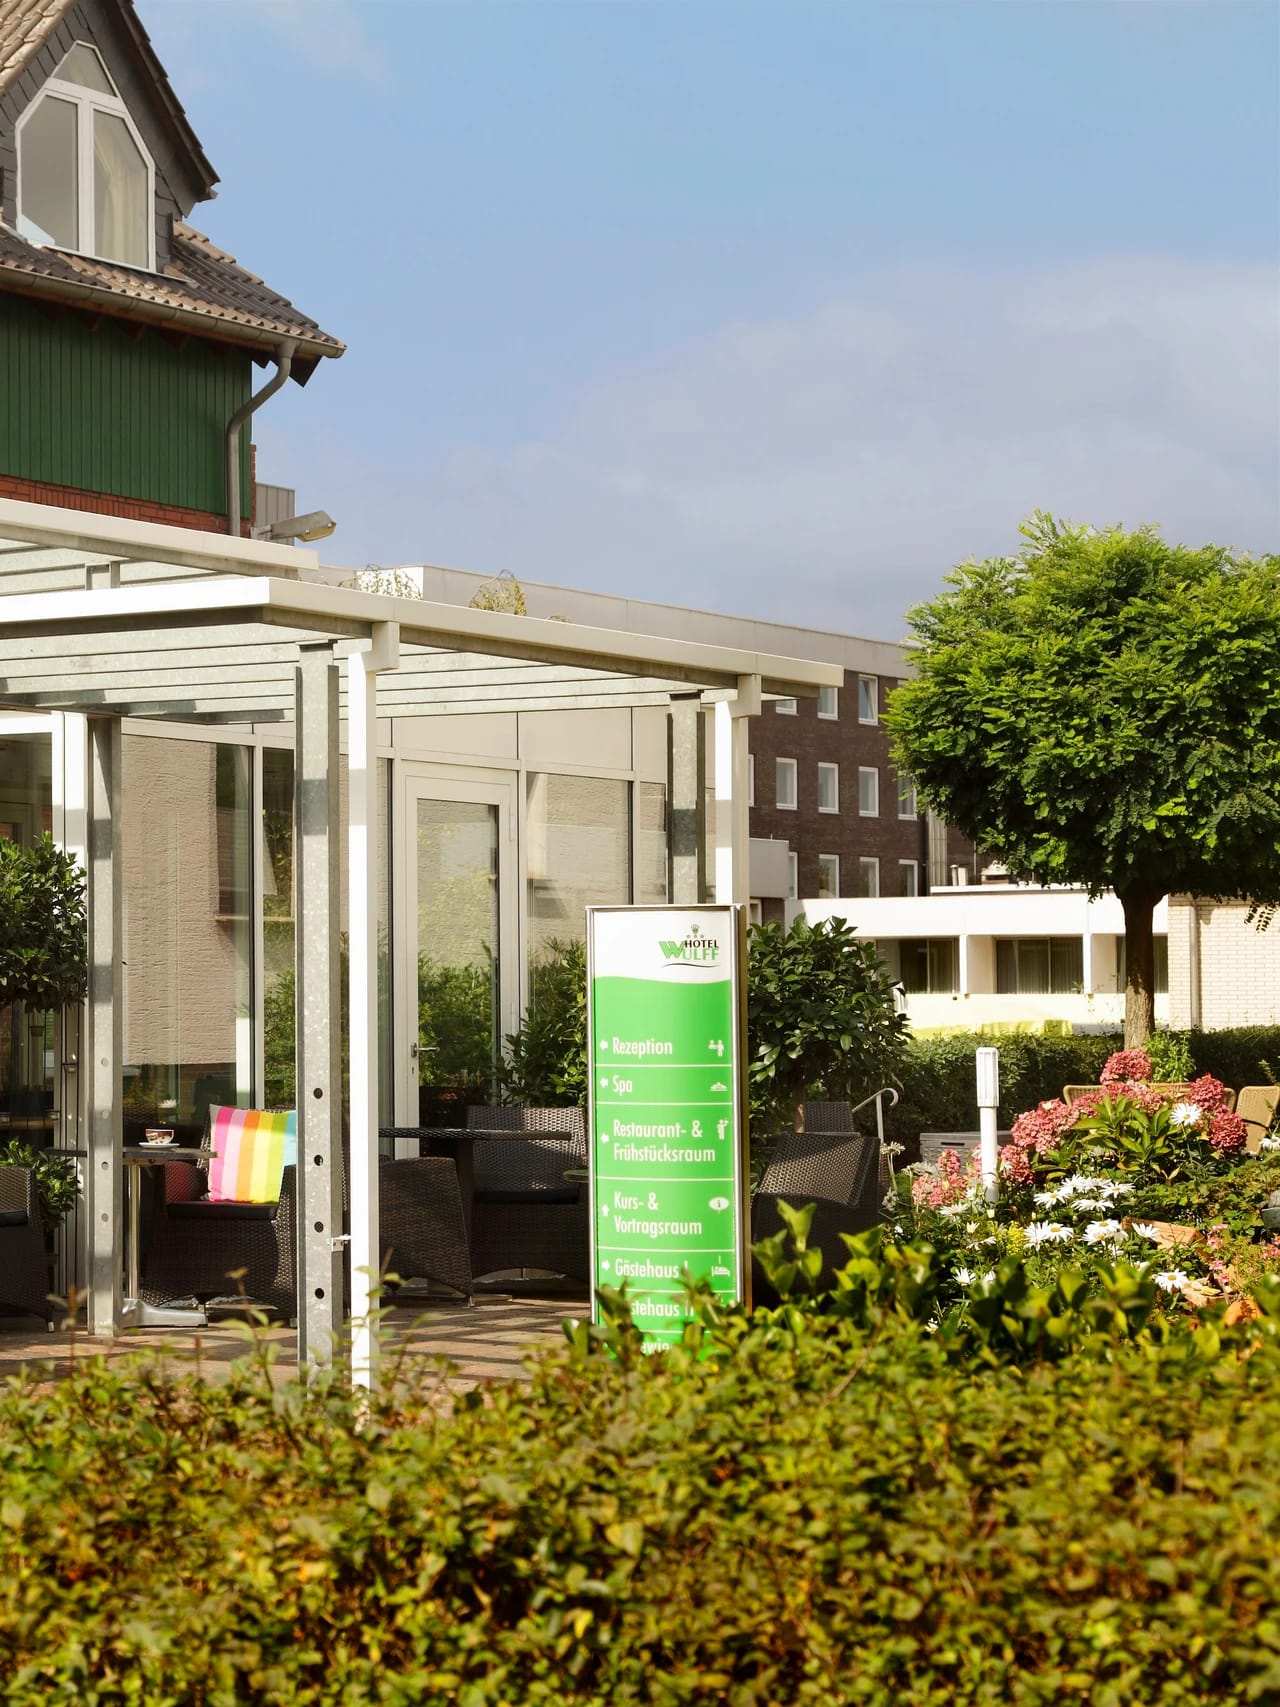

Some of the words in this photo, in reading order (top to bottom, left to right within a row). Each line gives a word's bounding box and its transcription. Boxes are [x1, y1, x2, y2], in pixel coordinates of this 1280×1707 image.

[658, 940, 719, 961] WULFF
[684, 939, 719, 949] HOTEL
[612, 1037, 672, 1059] Rezeption
[612, 1075, 632, 1097] Spa
[613, 1120, 687, 1137] Restaurant-
[692, 1120, 703, 1137] &
[613, 1143, 716, 1162] Frühstücksraum
[614, 1191, 643, 1210] Kurs-
[648, 1193, 659, 1211] &
[614, 1216, 702, 1237] Vortragsraum
[615, 1258, 679, 1277] Gästehaus
